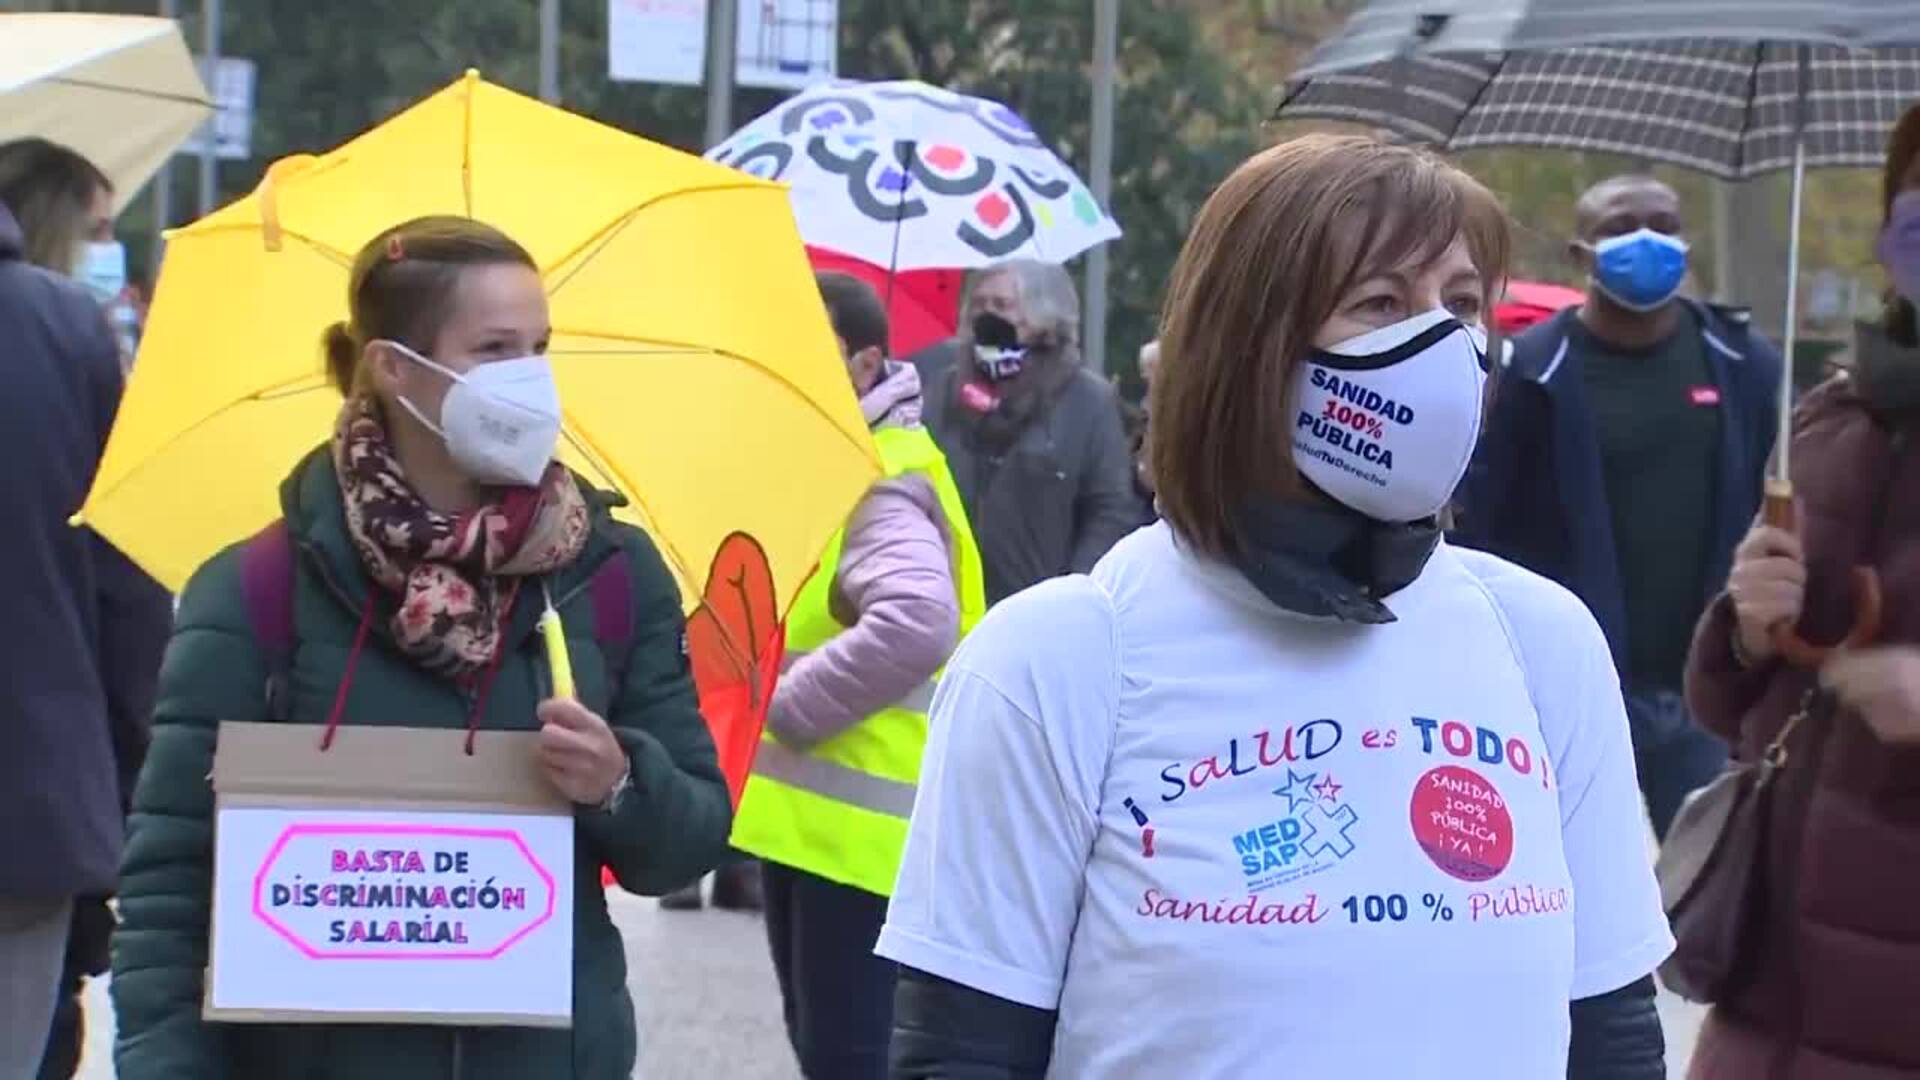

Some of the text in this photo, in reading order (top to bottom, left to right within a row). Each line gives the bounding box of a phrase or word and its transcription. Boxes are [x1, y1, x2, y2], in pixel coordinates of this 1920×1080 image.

[1310, 367, 1414, 425] SANIDAD
[1322, 399, 1383, 440] 100%
[1297, 410, 1393, 470] PÚBLICA
[1361, 729, 1398, 748] es
[1411, 717, 1532, 775] TODO
[1431, 773, 1503, 809] SANIDAD
[1445, 796, 1488, 823] 100%
[1232, 817, 1301, 854] MED
[1430, 810, 1497, 846] PÚBLICA
[331, 849, 469, 873] BASTA DE
[1241, 842, 1299, 877] SAP
[1450, 836, 1473, 857] YA
[1137, 884, 1568, 925] Sanidad 100 % Pública
